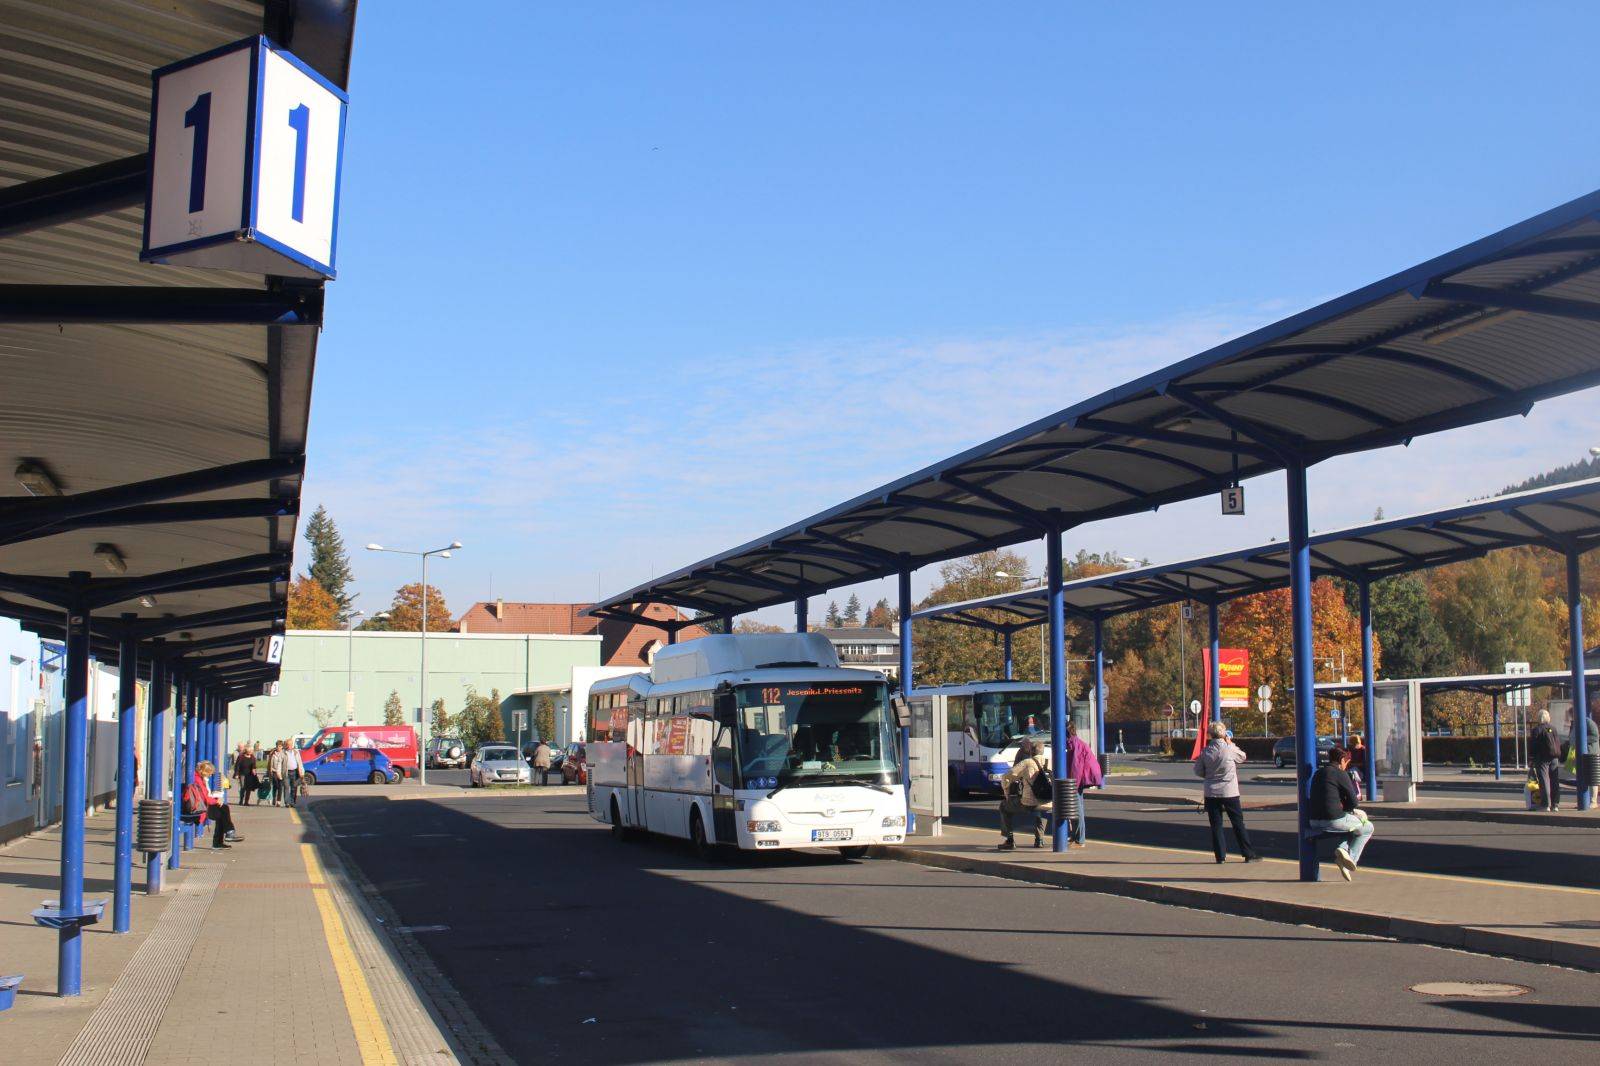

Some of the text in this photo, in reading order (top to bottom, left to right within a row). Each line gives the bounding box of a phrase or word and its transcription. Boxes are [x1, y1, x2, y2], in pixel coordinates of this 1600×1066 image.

[184, 91, 212, 215] 1
[287, 102, 310, 224] 1
[1228, 492, 1237, 509] 5
[1185, 608, 1190, 617] 9
[256, 638, 265, 656] 2
[271, 640, 279, 659] 2
[1218, 662, 1245, 671] PENNY
[762, 687, 781, 704] 112
[833, 830, 849, 838] 0553
